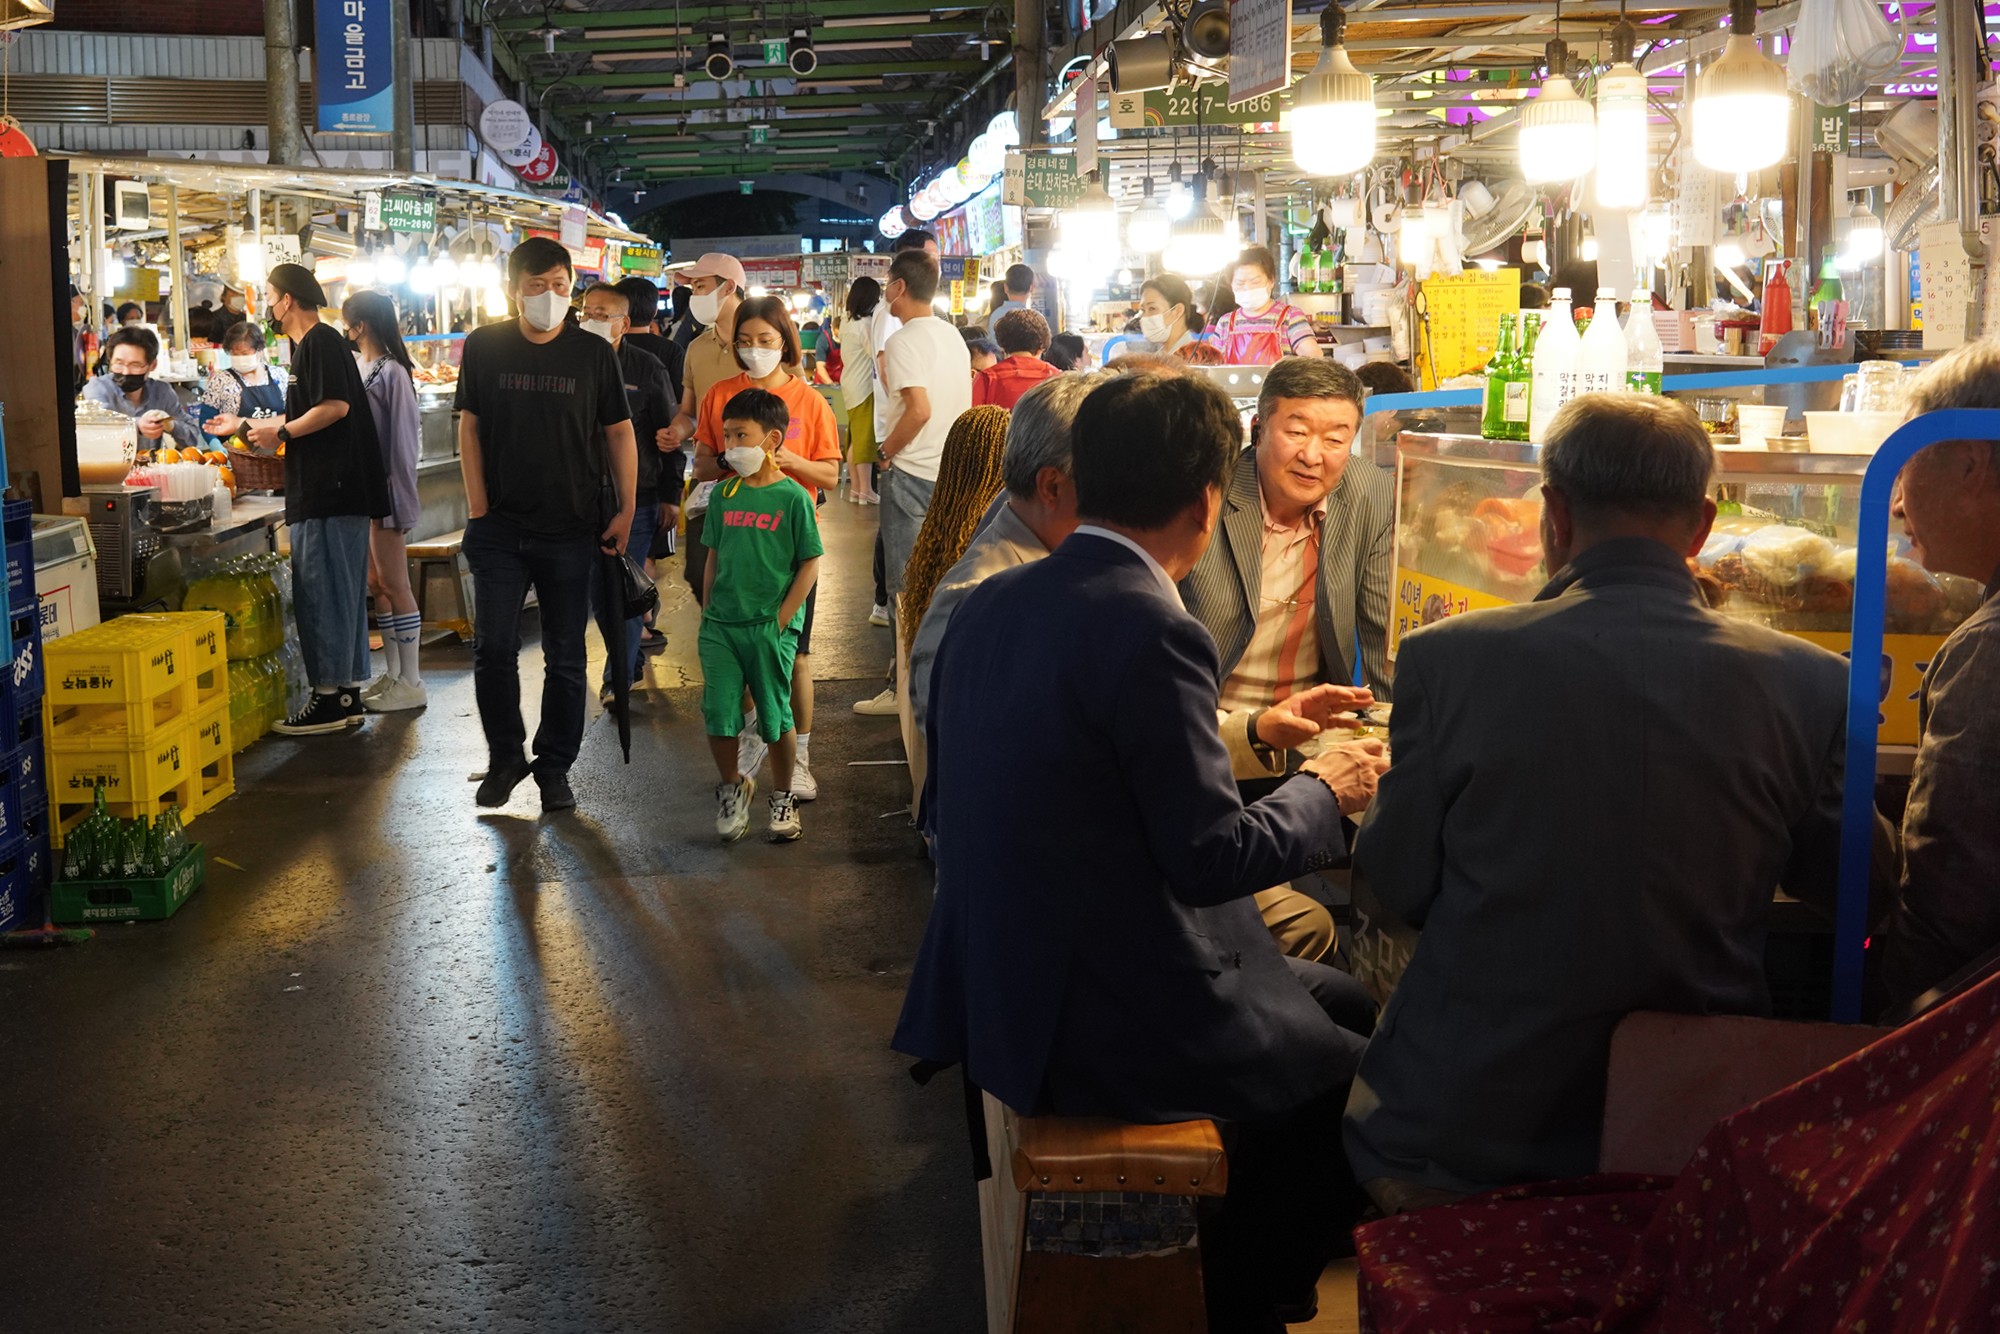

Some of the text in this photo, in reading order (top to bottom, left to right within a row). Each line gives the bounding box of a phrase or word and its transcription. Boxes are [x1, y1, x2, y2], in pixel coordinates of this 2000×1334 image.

[343, 0, 367, 90] 마을금고
[1119, 99, 1136, 115] 호
[1167, 96, 1272, 117] 2267-0186
[388, 217, 432, 230] 2271-2690
[1981, 221, 1991, 235] 5
[1944, 275, 1953, 283] 10
[499, 373, 576, 395] REVOLUTION
[1400, 579, 1422, 615] 40년
[62, 677, 114, 690] 서울탁주
[68, 776, 120, 788] 서울탁주
